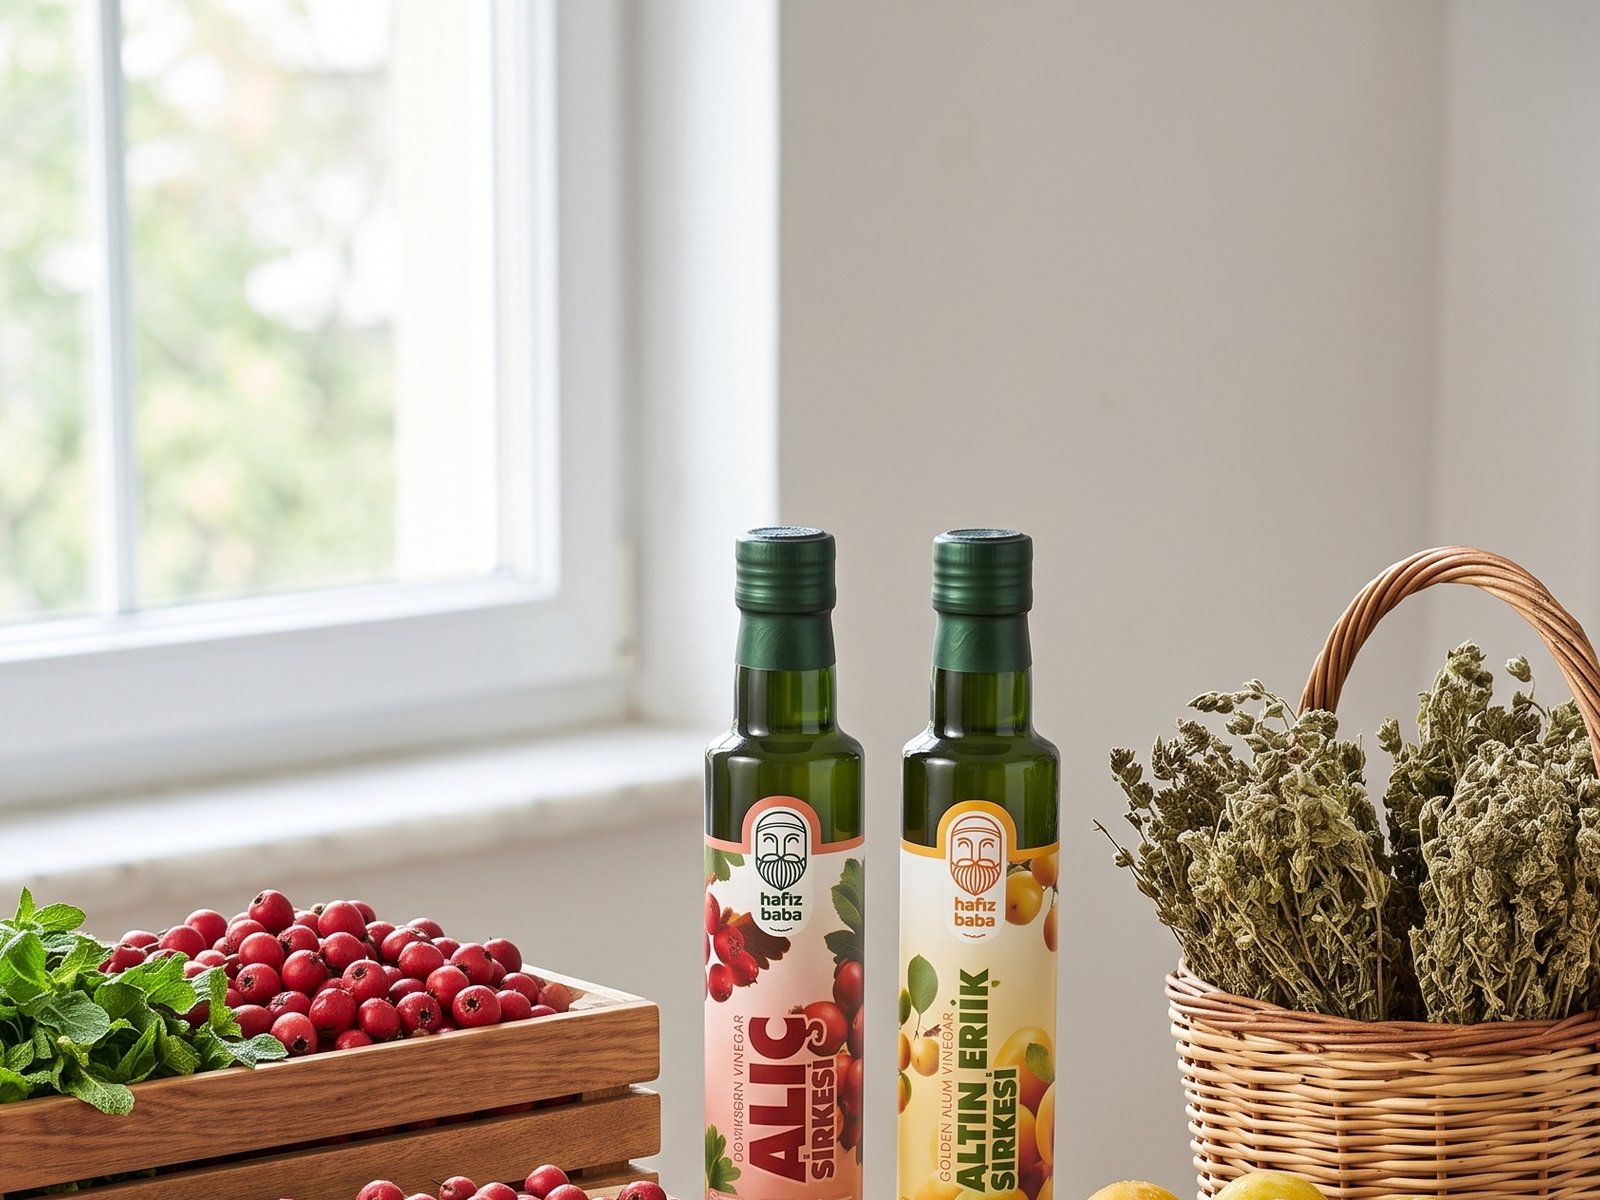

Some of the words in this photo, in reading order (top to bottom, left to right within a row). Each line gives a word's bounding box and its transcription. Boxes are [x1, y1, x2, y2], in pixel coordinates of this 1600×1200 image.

[760, 891, 803, 906] hafiz
[954, 896, 996, 912] hafiz
[760, 907, 802, 921] baba
[954, 913, 996, 928] baba
[733, 1014, 744, 1077] VINEGAR
[956, 1082, 988, 1193] ALTIN
[939, 1123, 953, 1183] GOLDEN
